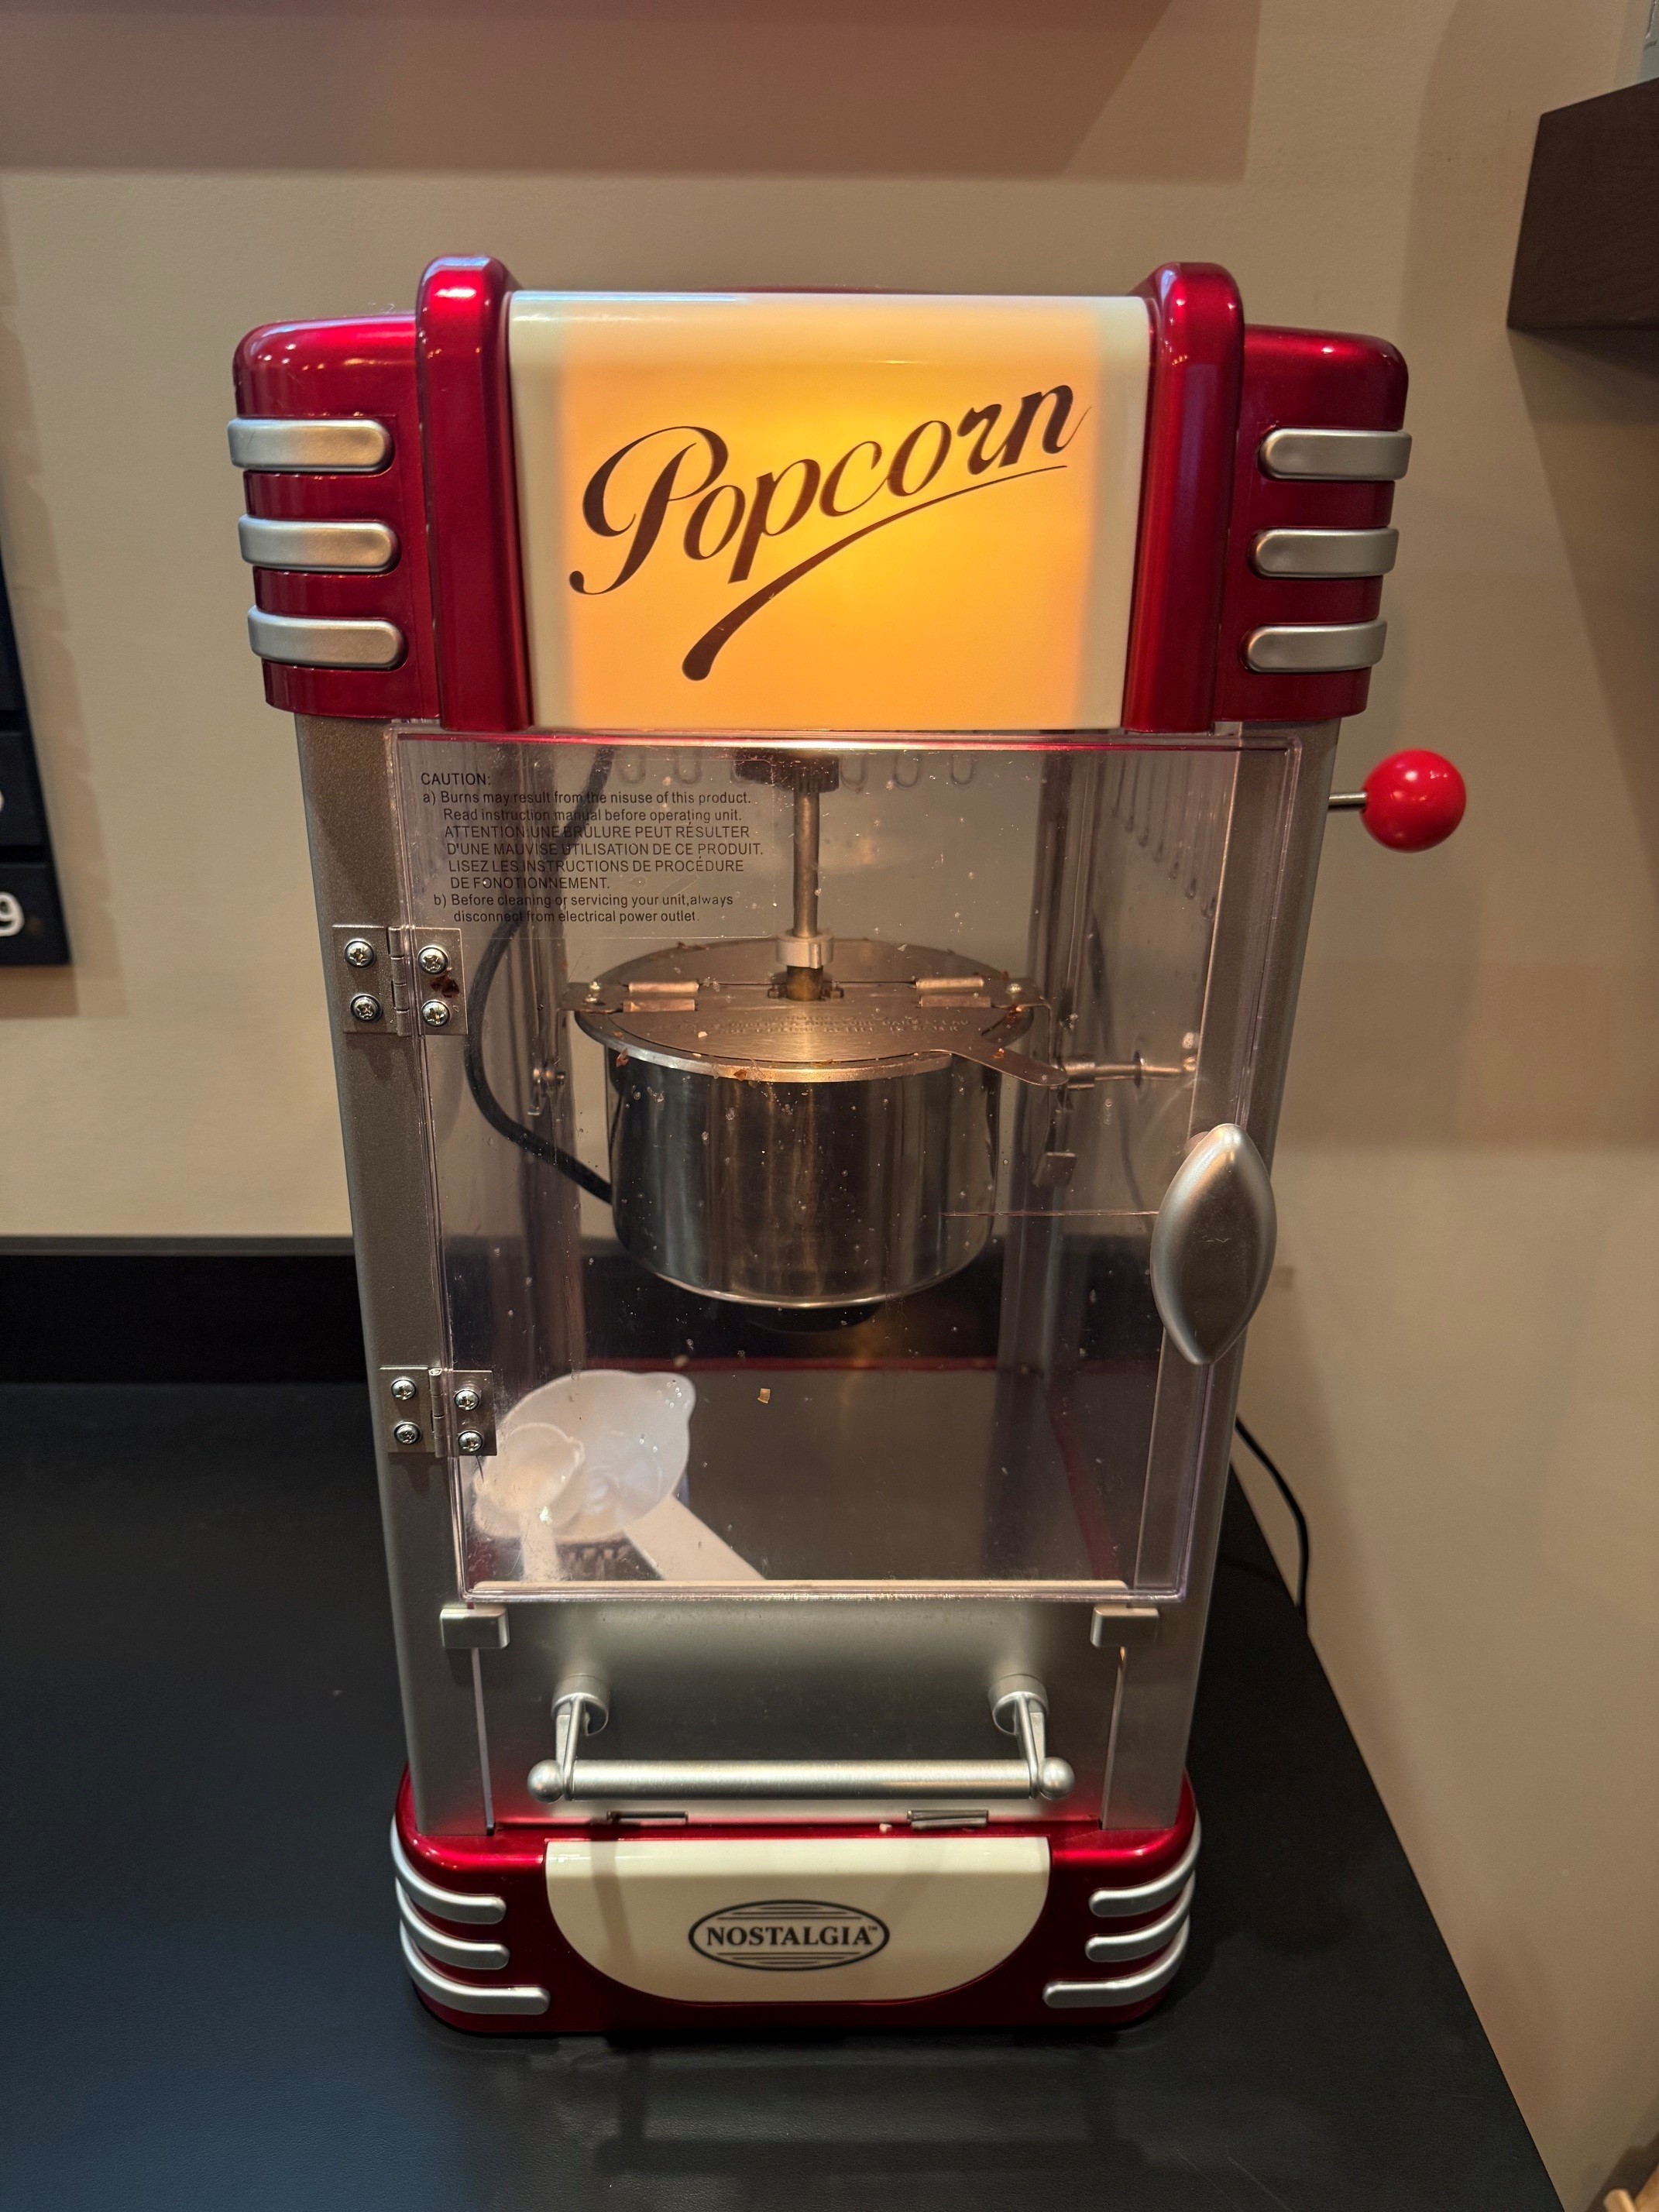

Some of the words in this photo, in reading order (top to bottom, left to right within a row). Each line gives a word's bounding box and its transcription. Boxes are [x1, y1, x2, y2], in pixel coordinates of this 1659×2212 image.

[569, 384, 1091, 596] Popcorn
[421, 773, 491, 785] CAUTION:
[423, 791, 436, 805] a)
[441, 790, 479, 803] Burns
[483, 793, 510, 806] may
[514, 791, 551, 803] result
[554, 791, 582, 803] from
[586, 791, 606, 803] the
[610, 792, 653, 804] nisuse
[656, 791, 670, 804] of
[672, 792, 695, 804] this
[699, 792, 751, 805] product.
[444, 808, 477, 820] Read
[482, 809, 550, 821] instruction
[555, 809, 601, 821] manual
[605, 809, 646, 821] before
[650, 809, 710, 823] operating
[715, 809, 742, 821] unit.
[563, 823, 631, 838] BRÛLURE
[635, 826, 672, 838] PEUT
[676, 822, 750, 838] RÉSULTER
[447, 843, 489, 855] D'UNE
[494, 843, 557, 855] MAUVISE
[562, 843, 648, 855] UTILISATION
[653, 843, 672, 855] DE
[675, 843, 693, 855] CE
[698, 843, 764, 855] PRODUIT.
[448, 860, 489, 872] LISEZ
[493, 860, 519, 872] LES
[523, 860, 629, 872] INSTRUCTIONS
[633, 860, 651, 872] DE
[655, 856, 744, 872] PROCÉDURE
[451, 877, 470, 889] DE
[434, 894, 447, 908] b)
[452, 894, 494, 905] Before
[497, 894, 551, 908] cleaning
[555, 896, 568, 905] or
[571, 895, 627, 908] servicing
[631, 896, 659, 908] your
[454, 911, 523, 922] disconnect
[527, 911, 555, 922] from
[558, 910, 616, 922] electrical
[620, 912, 658, 925] power
[661, 911, 700, 922] outlet.
